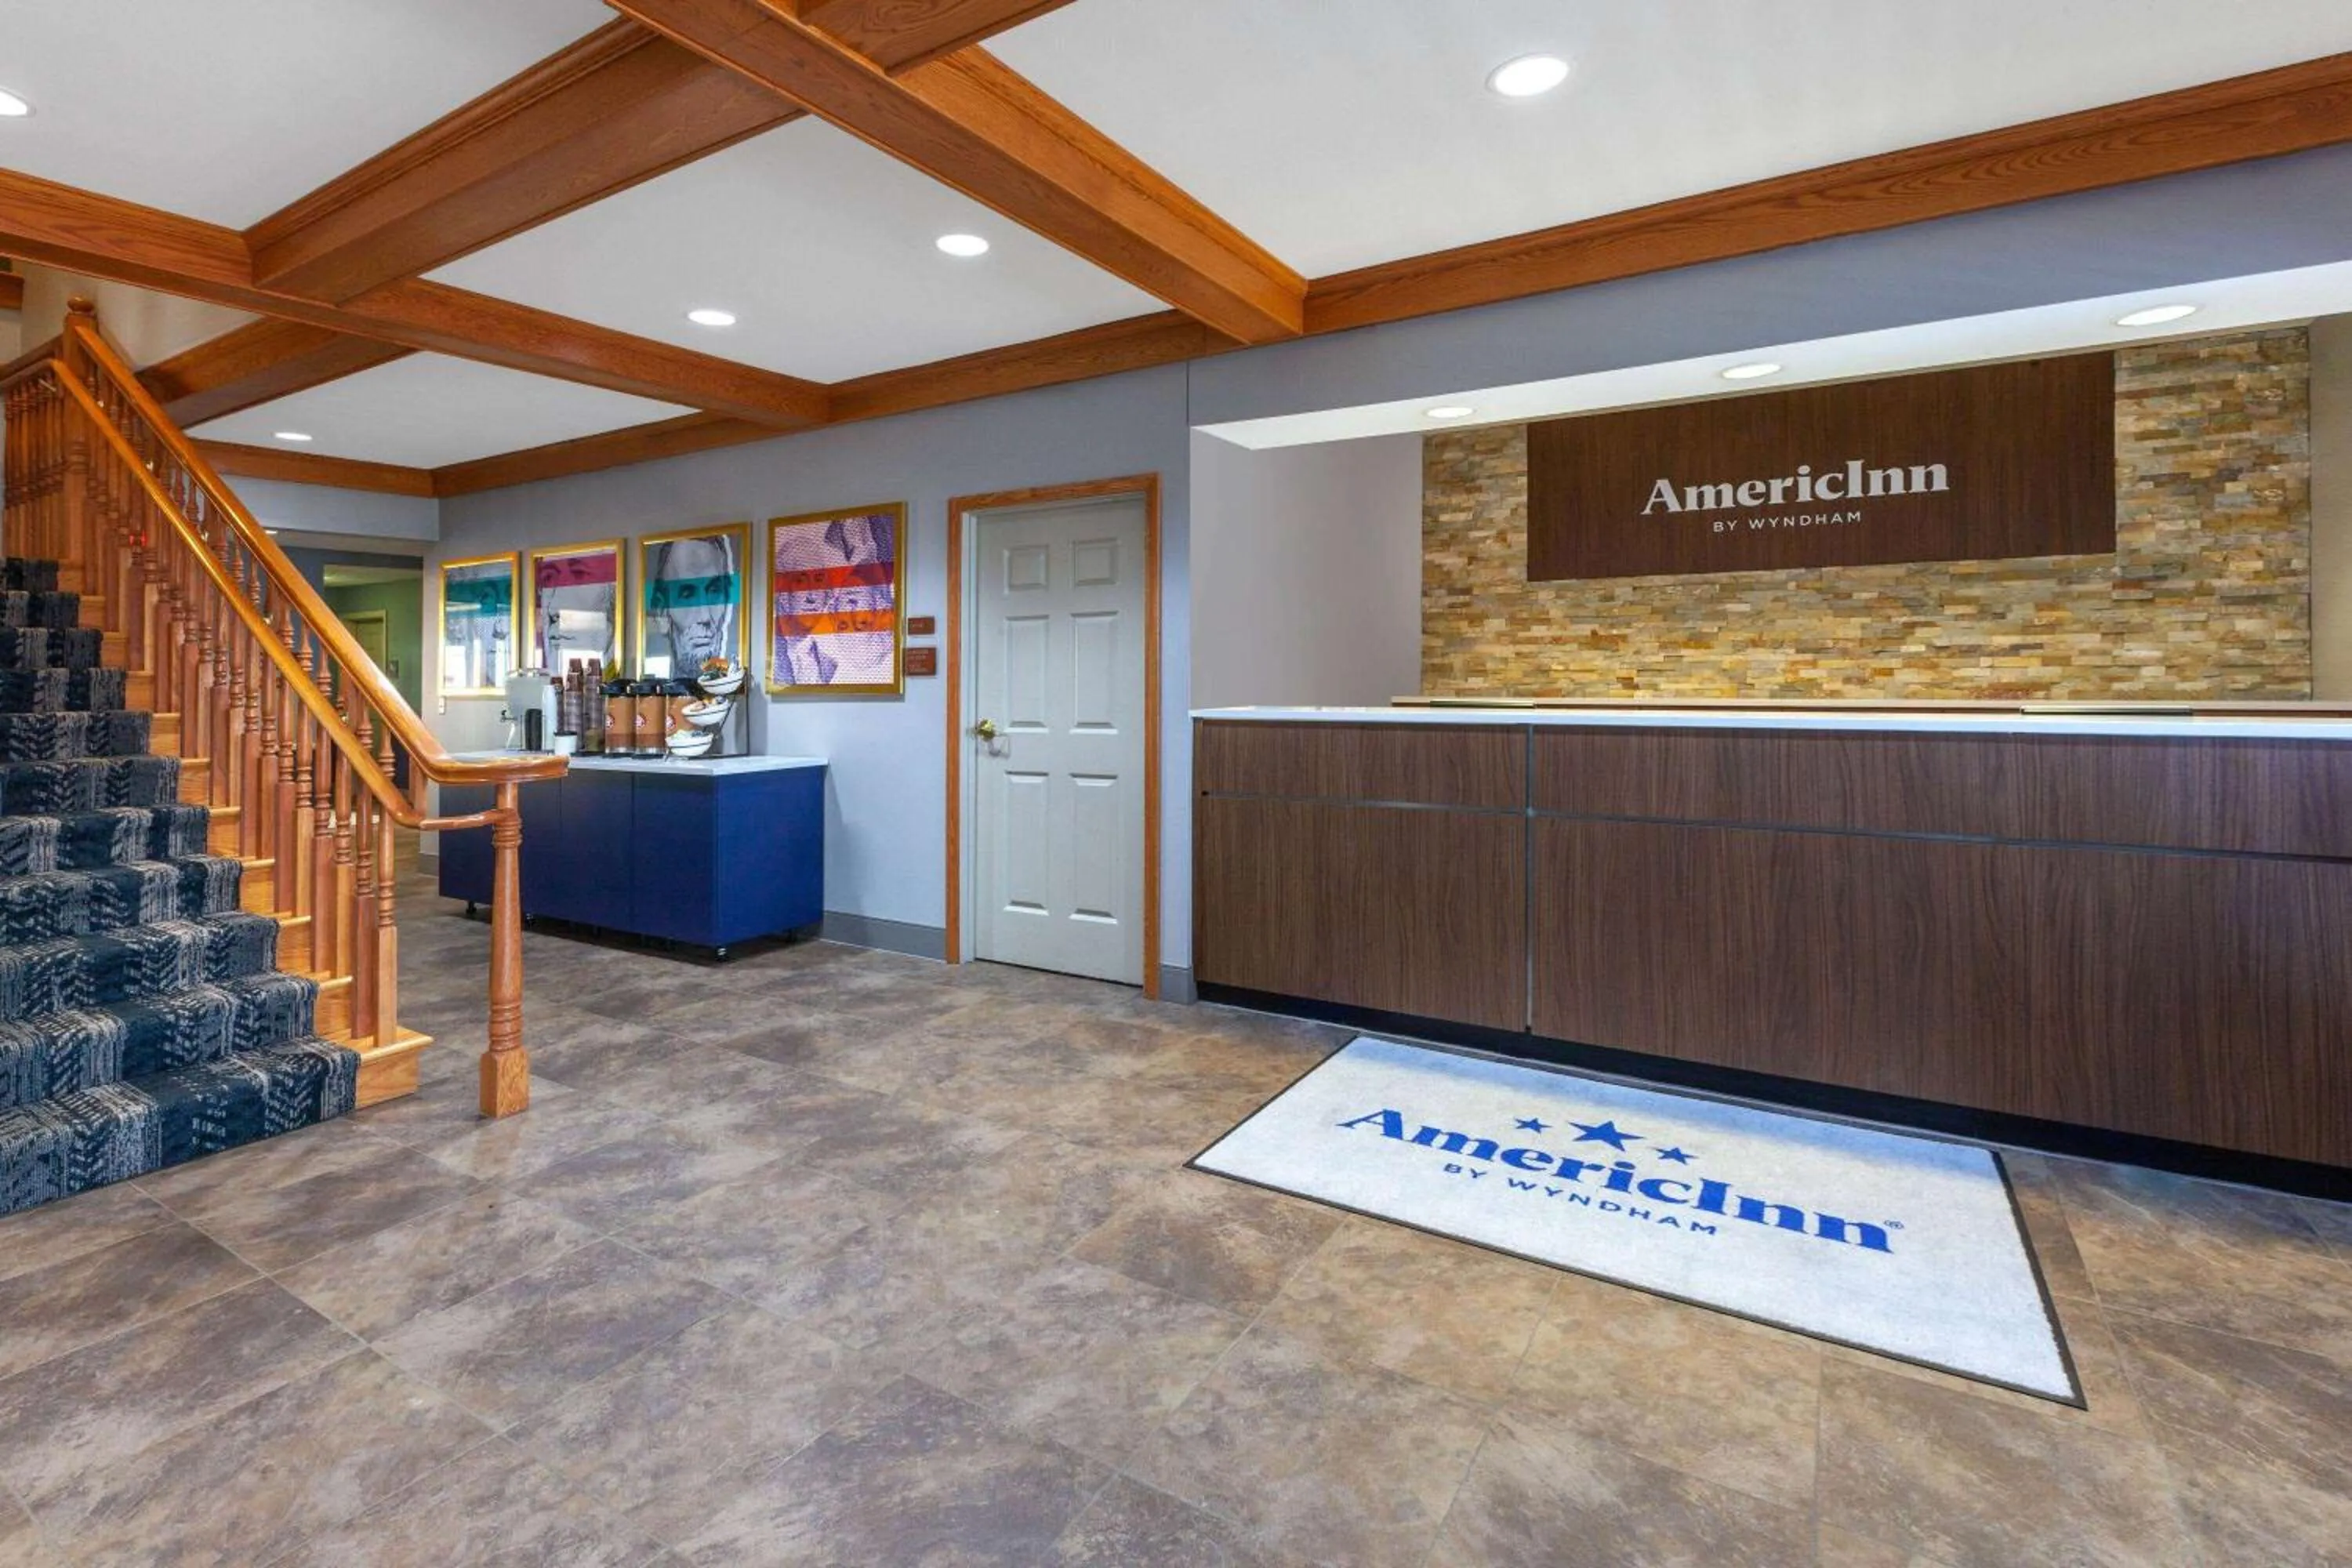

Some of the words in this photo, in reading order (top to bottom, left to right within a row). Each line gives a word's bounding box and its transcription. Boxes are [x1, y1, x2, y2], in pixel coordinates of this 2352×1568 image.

[1640, 459, 1950, 515] AmericInn
[1713, 520, 1737, 533] BY
[1749, 511, 1861, 530] WYNDHAM
[1443, 1163, 1488, 1179] BY
[1507, 1178, 1718, 1236] WYNDHAM
